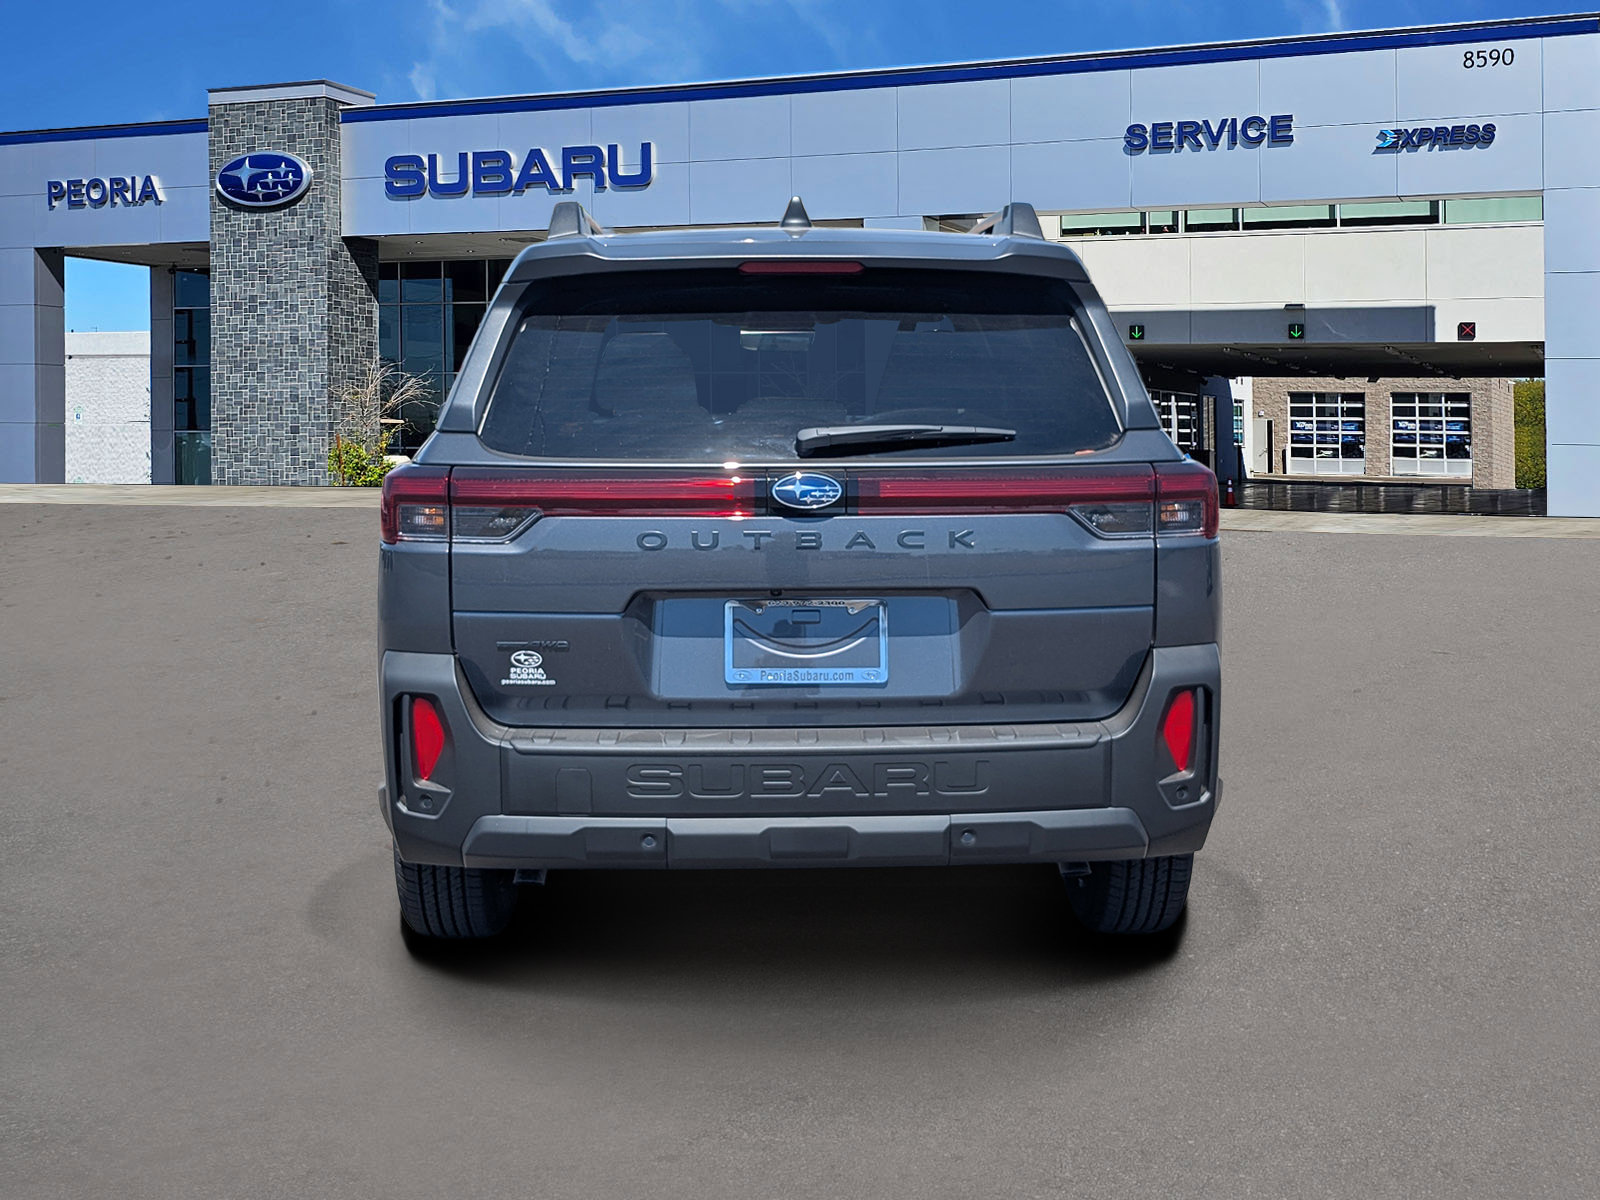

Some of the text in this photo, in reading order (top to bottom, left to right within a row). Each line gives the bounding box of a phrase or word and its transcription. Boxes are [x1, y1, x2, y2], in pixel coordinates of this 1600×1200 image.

[1462, 47, 1515, 69] 8590
[1124, 114, 1294, 151] SERVICE
[1374, 122, 1497, 149] EXPRESS
[384, 141, 652, 197] SUBARU
[47, 174, 162, 209] PEORIA
[636, 529, 976, 551] OUTBACK
[760, 670, 854, 682] PeoriaSubaru.com
[625, 759, 990, 798] SUBARU
